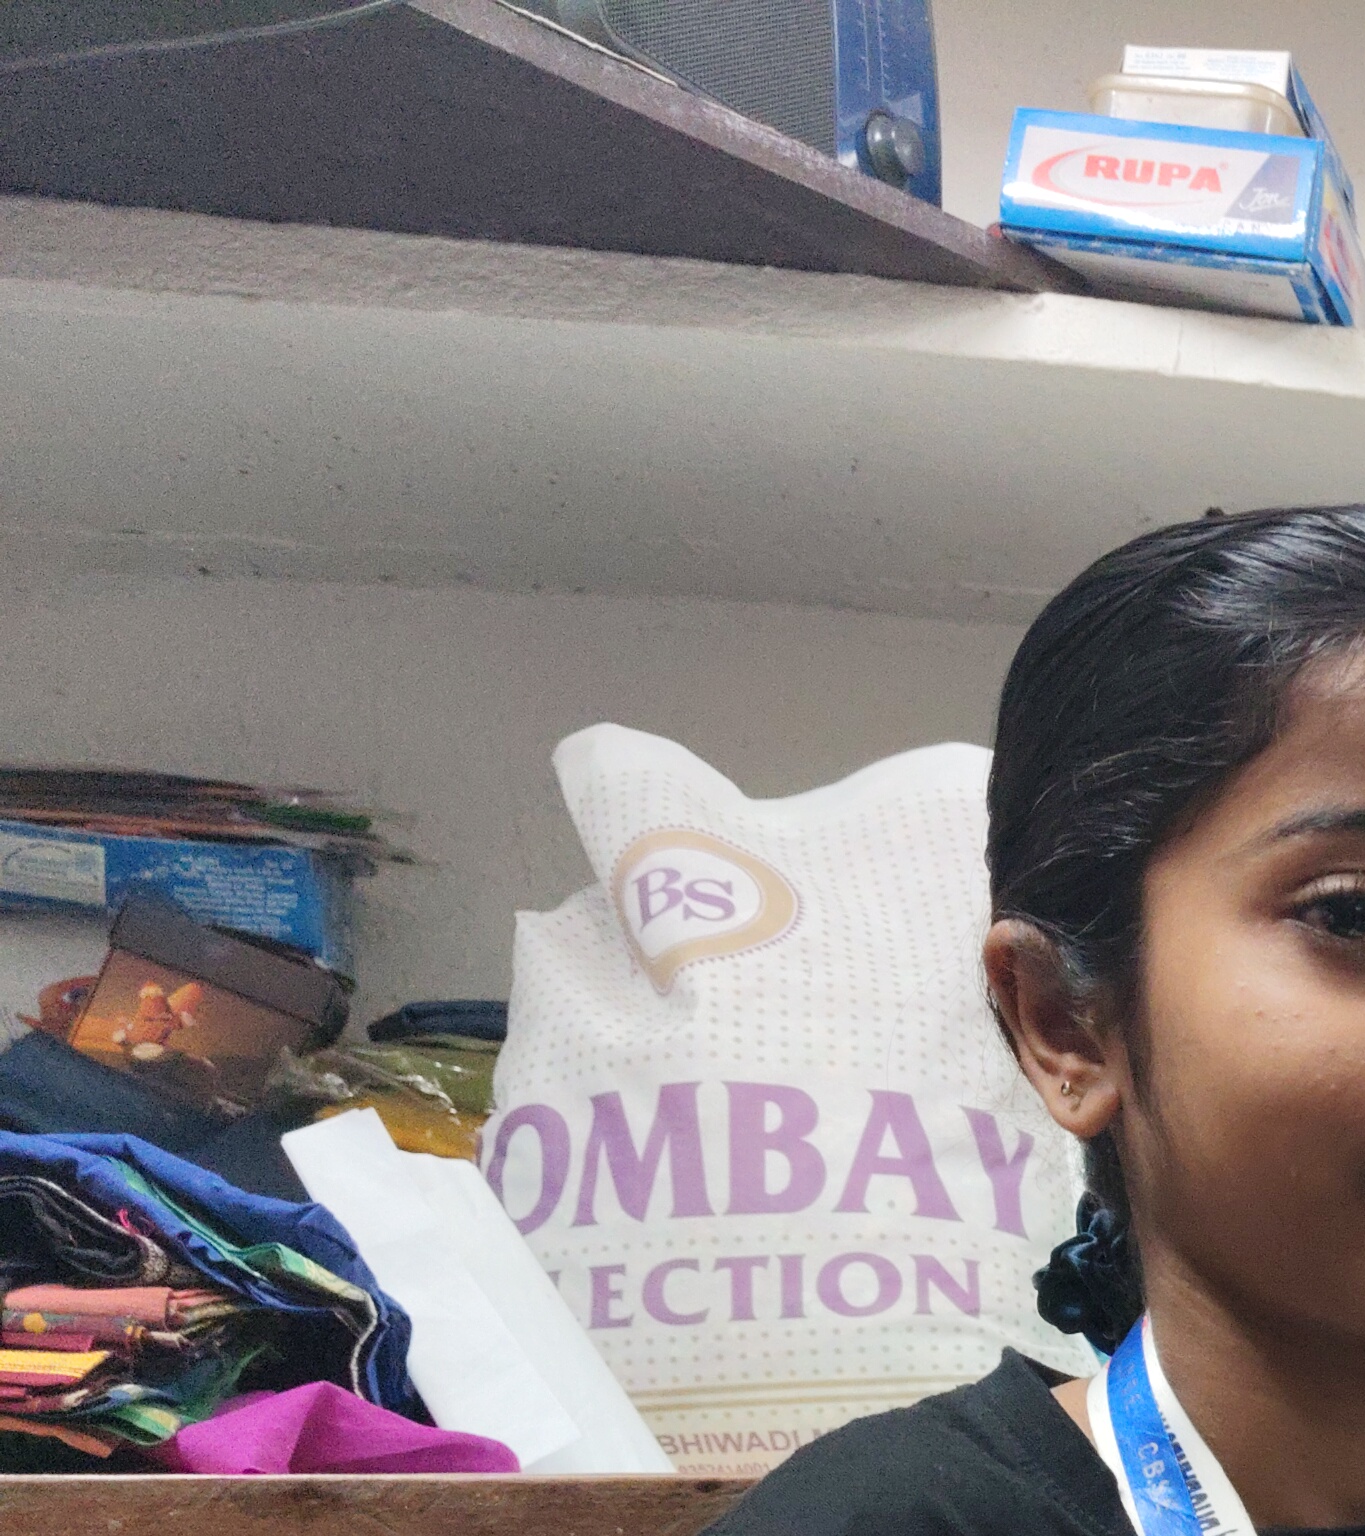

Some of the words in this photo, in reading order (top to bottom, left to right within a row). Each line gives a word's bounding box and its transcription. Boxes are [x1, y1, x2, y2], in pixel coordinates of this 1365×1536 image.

[1084, 154, 1224, 194] RUPA
[632, 866, 736, 933] BS
[478, 1080, 1036, 1240] OMBAY
[548, 1251, 981, 1331] ECTION
